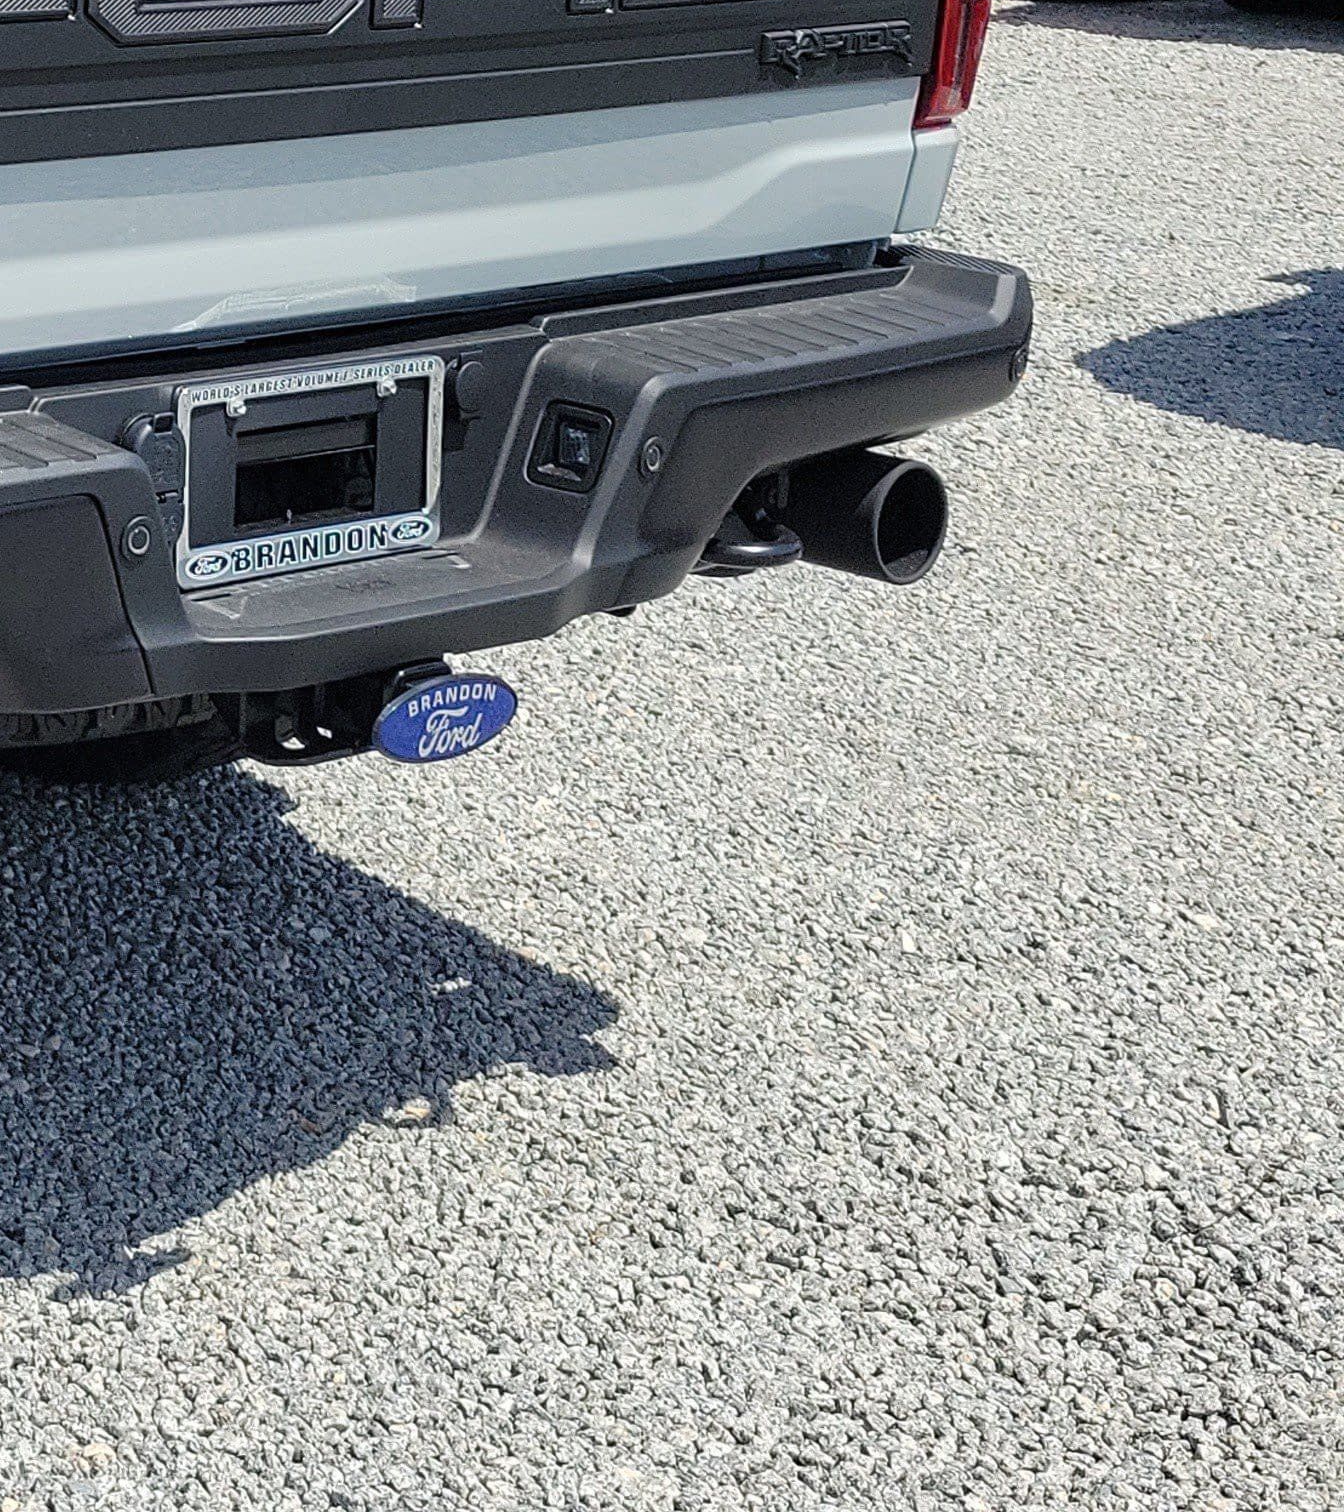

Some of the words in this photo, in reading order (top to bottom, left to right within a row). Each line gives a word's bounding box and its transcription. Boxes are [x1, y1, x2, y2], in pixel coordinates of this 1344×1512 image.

[759, 18, 914, 81] RAPTOR
[192, 385, 240, 403] WORLD'S
[244, 378, 292, 395] LARGEST
[297, 370, 340, 387] VOLUME
[353, 365, 391, 380] SERIES
[394, 360, 435, 374] DEALER
[231, 522, 388, 572] BRANDON
[408, 683, 497, 717] BRANDON
[418, 706, 483, 758] Ford
